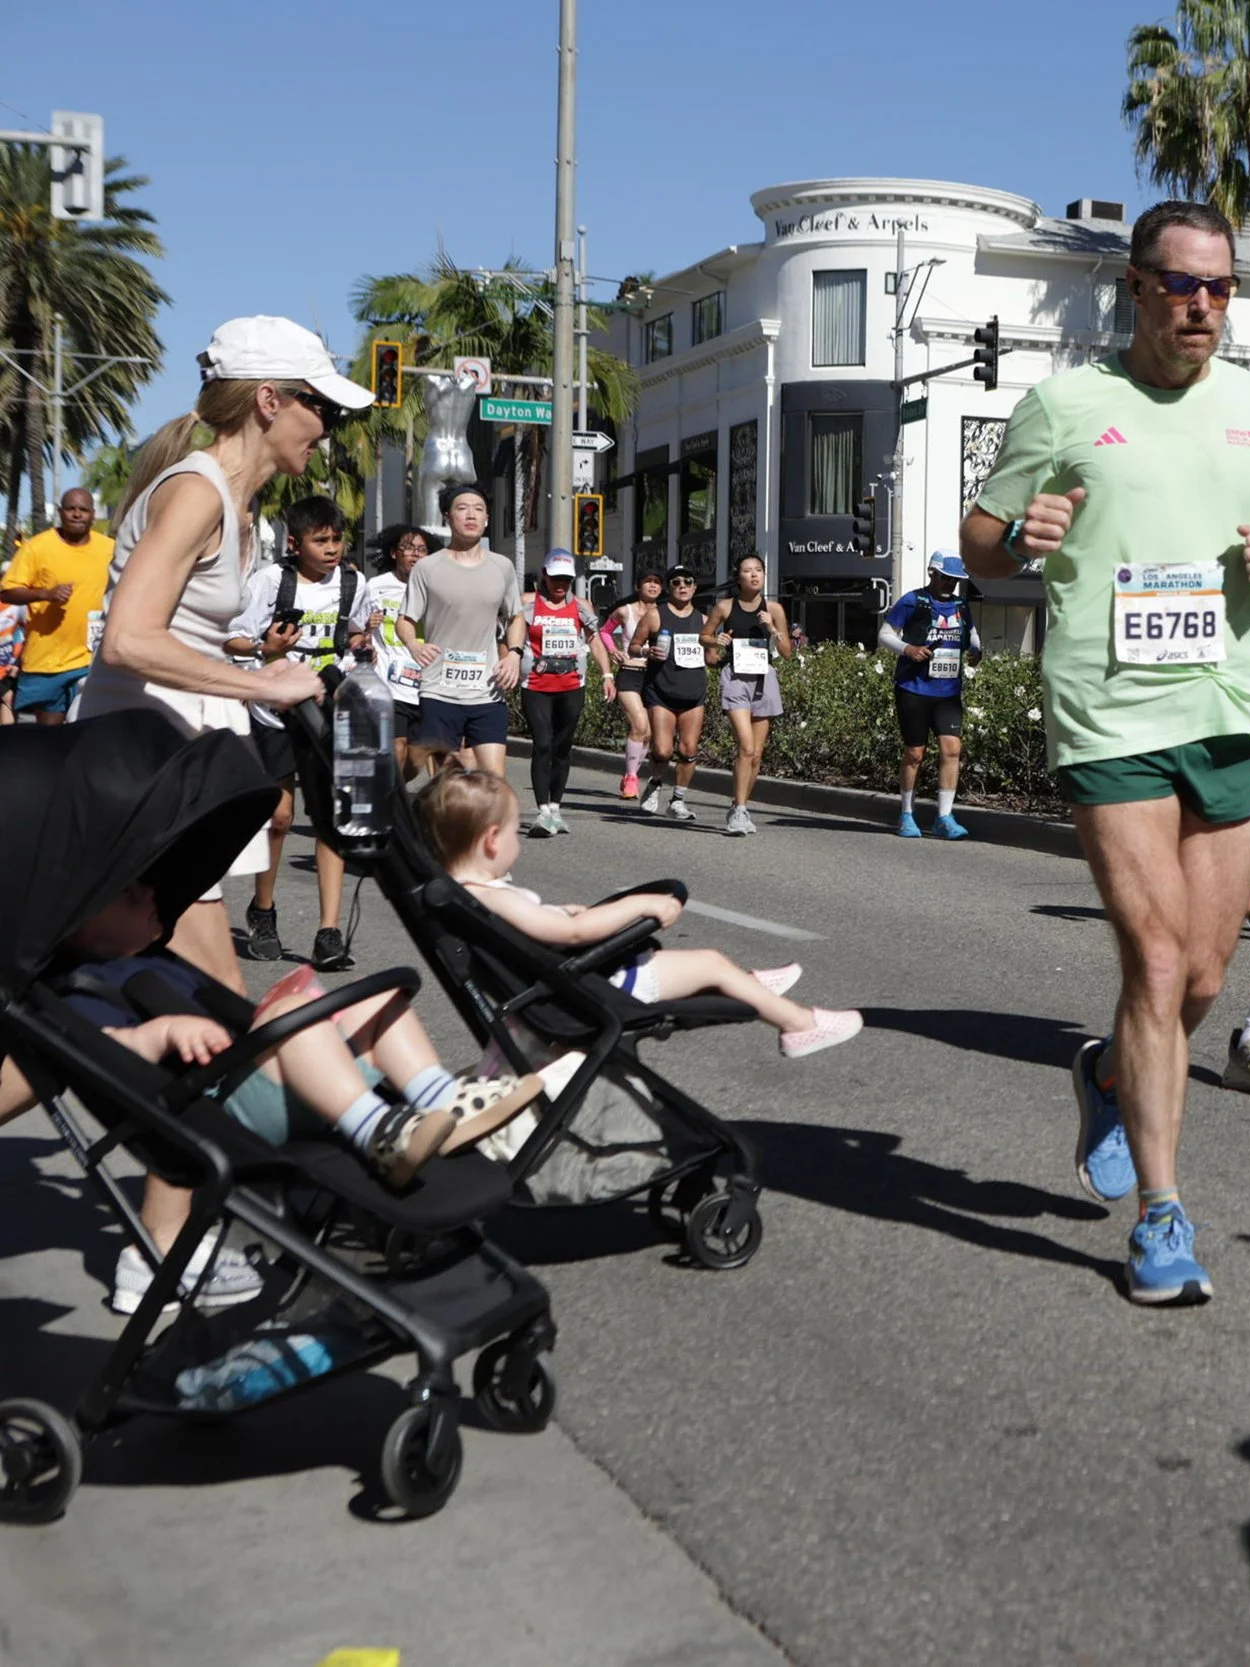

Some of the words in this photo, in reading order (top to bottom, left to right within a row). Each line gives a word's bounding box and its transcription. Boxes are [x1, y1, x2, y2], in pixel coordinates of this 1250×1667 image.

[775, 218, 796, 237] Van
[798, 211, 843, 233] Cleef
[847, 217, 860, 231] &
[867, 213, 929, 236] Arpels
[486, 403, 532, 419] Dayton
[535, 406, 552, 420] Wa
[788, 541, 805, 553] Van
[806, 540, 834, 553] Cleef
[835, 543, 844, 553] &
[1142, 573, 1159, 581] LOS
[1166, 572, 1203, 581] ANGELES
[1142, 580, 1203, 590] MARATHON
[1124, 610, 1216, 640] E6768
[544, 640, 575, 649] E6013
[931, 662, 958, 672] E8610
[445, 667, 483, 681] E7037
